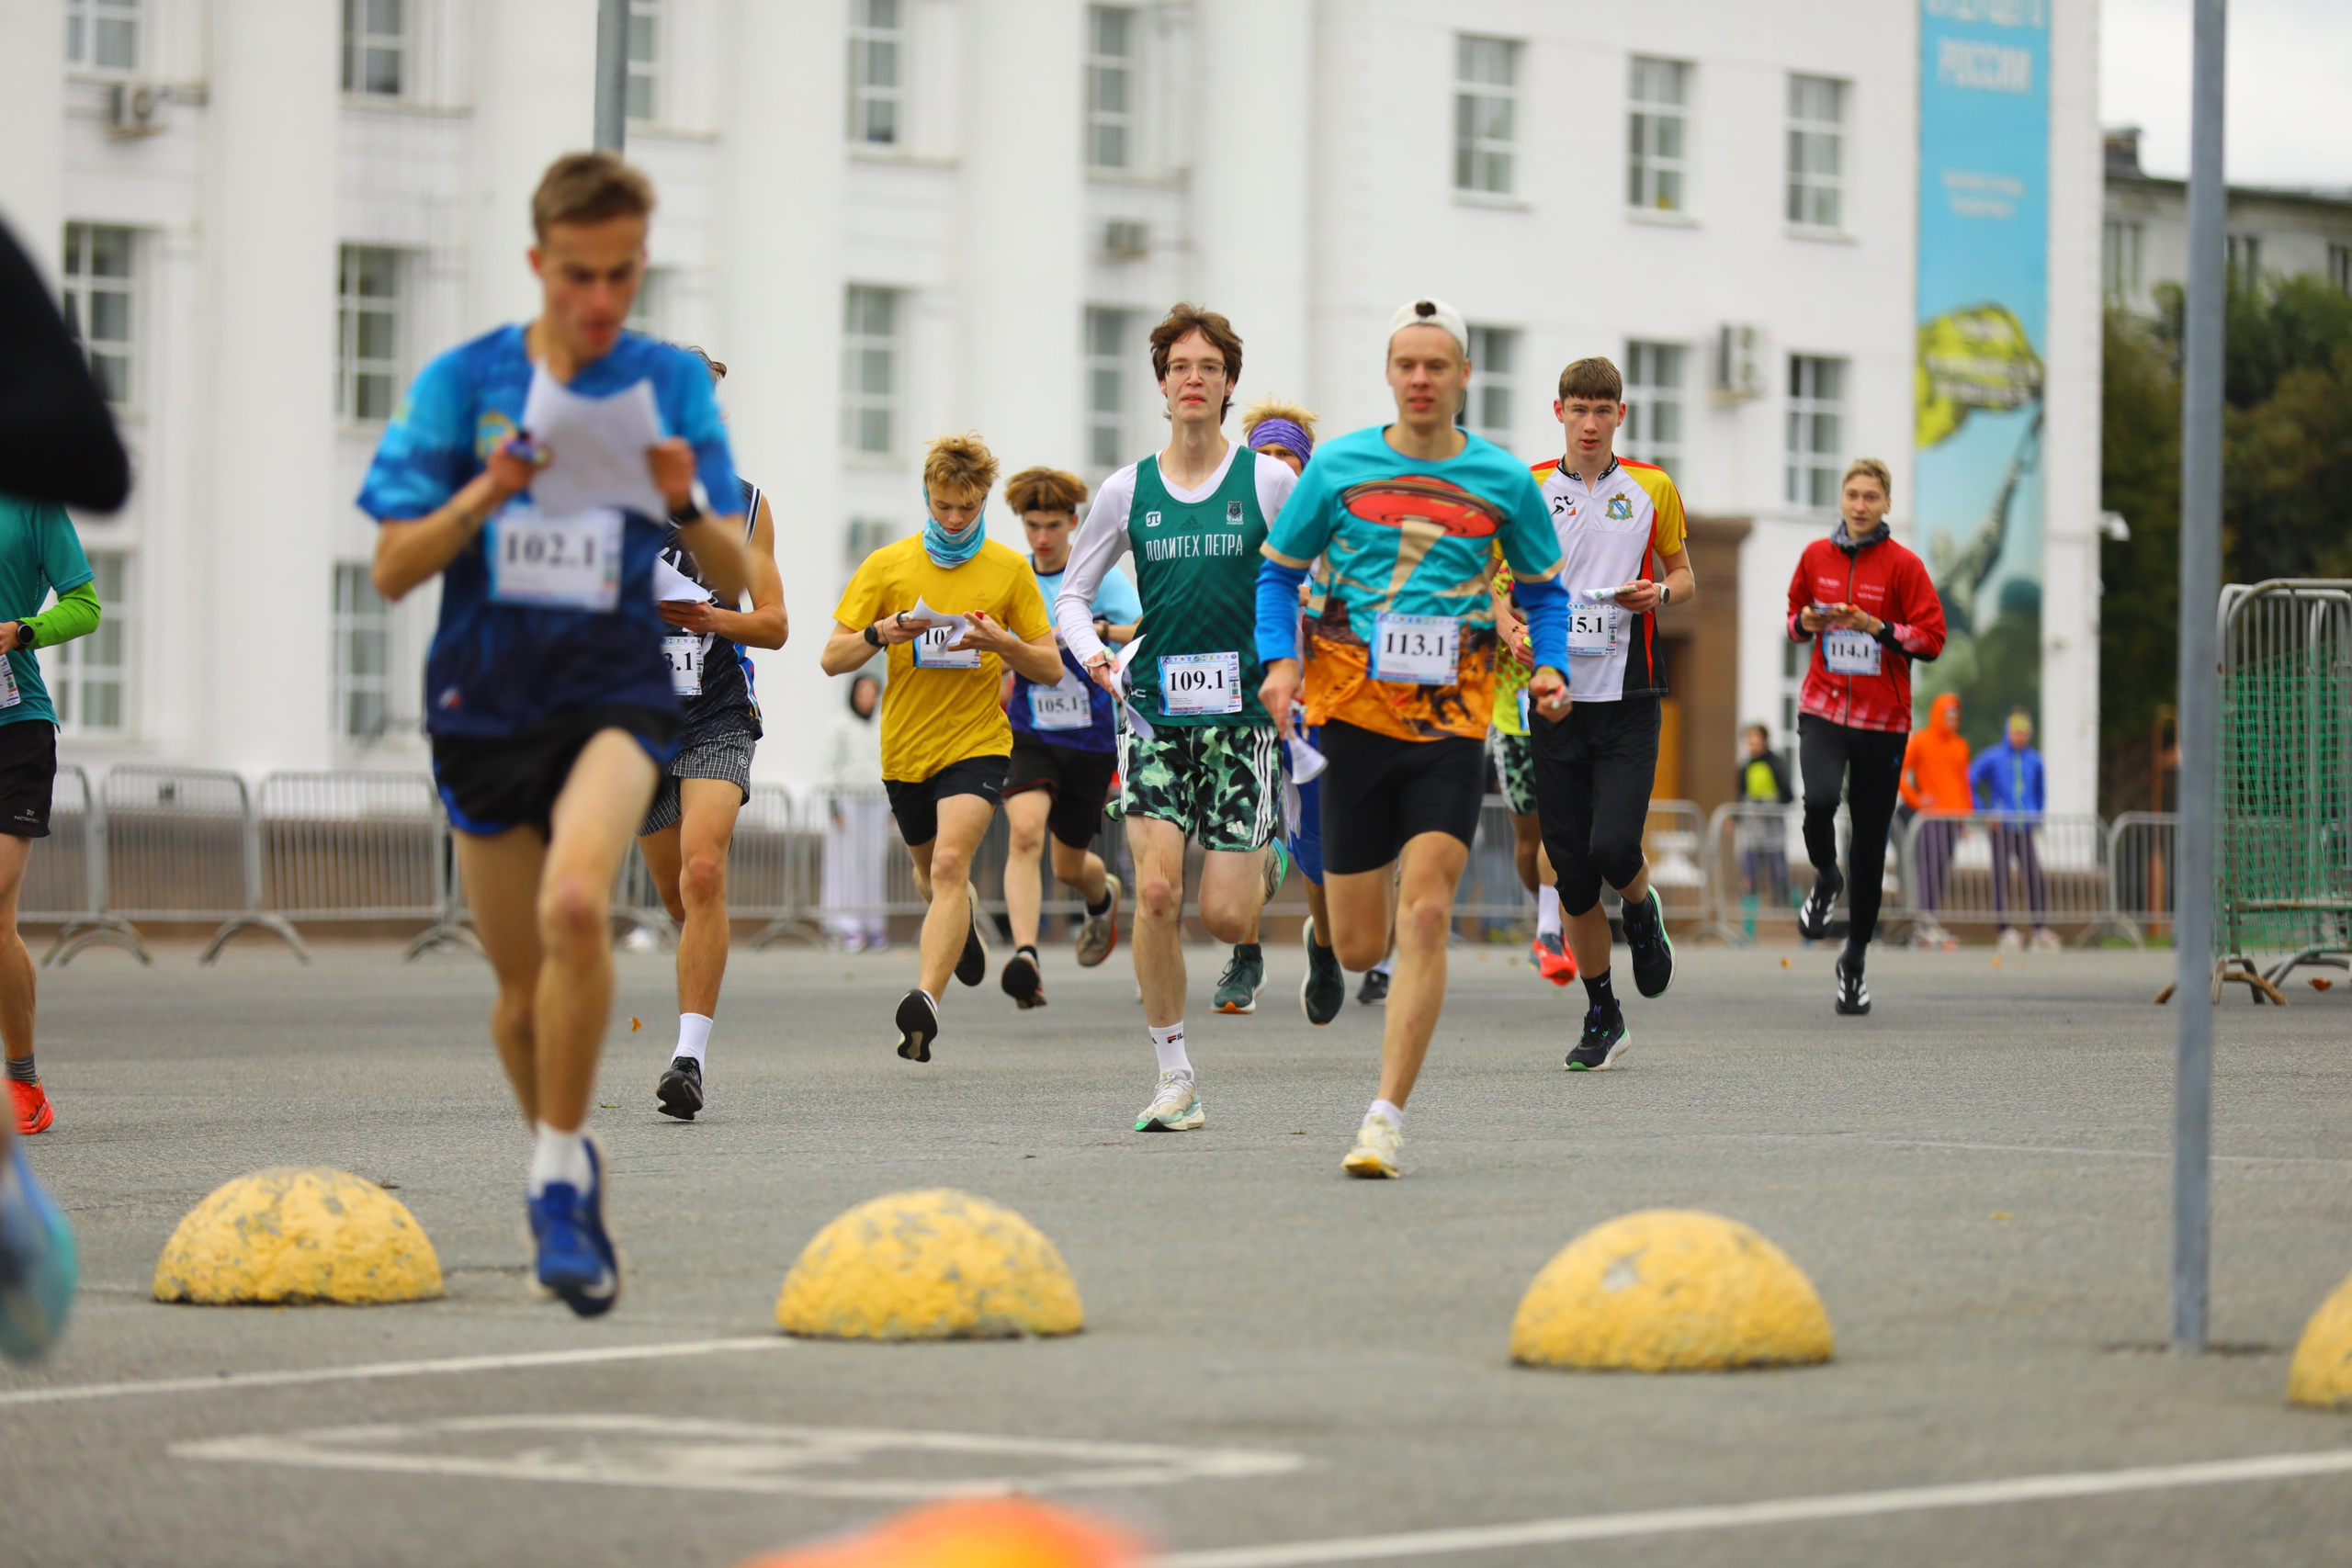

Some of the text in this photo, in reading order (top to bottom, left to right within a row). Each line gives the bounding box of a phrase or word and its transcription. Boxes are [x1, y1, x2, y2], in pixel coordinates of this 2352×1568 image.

[506, 531, 595, 568] 102.1
[1146, 534, 1243, 562] ПОЛИТЕХ ПЕТРА
[925, 628, 950, 645] 10
[1385, 632, 1444, 657] 113.1
[1831, 643, 1869, 659] 114.1
[1170, 670, 1225, 691] 109.1
[1037, 696, 1078, 713] 105.1
